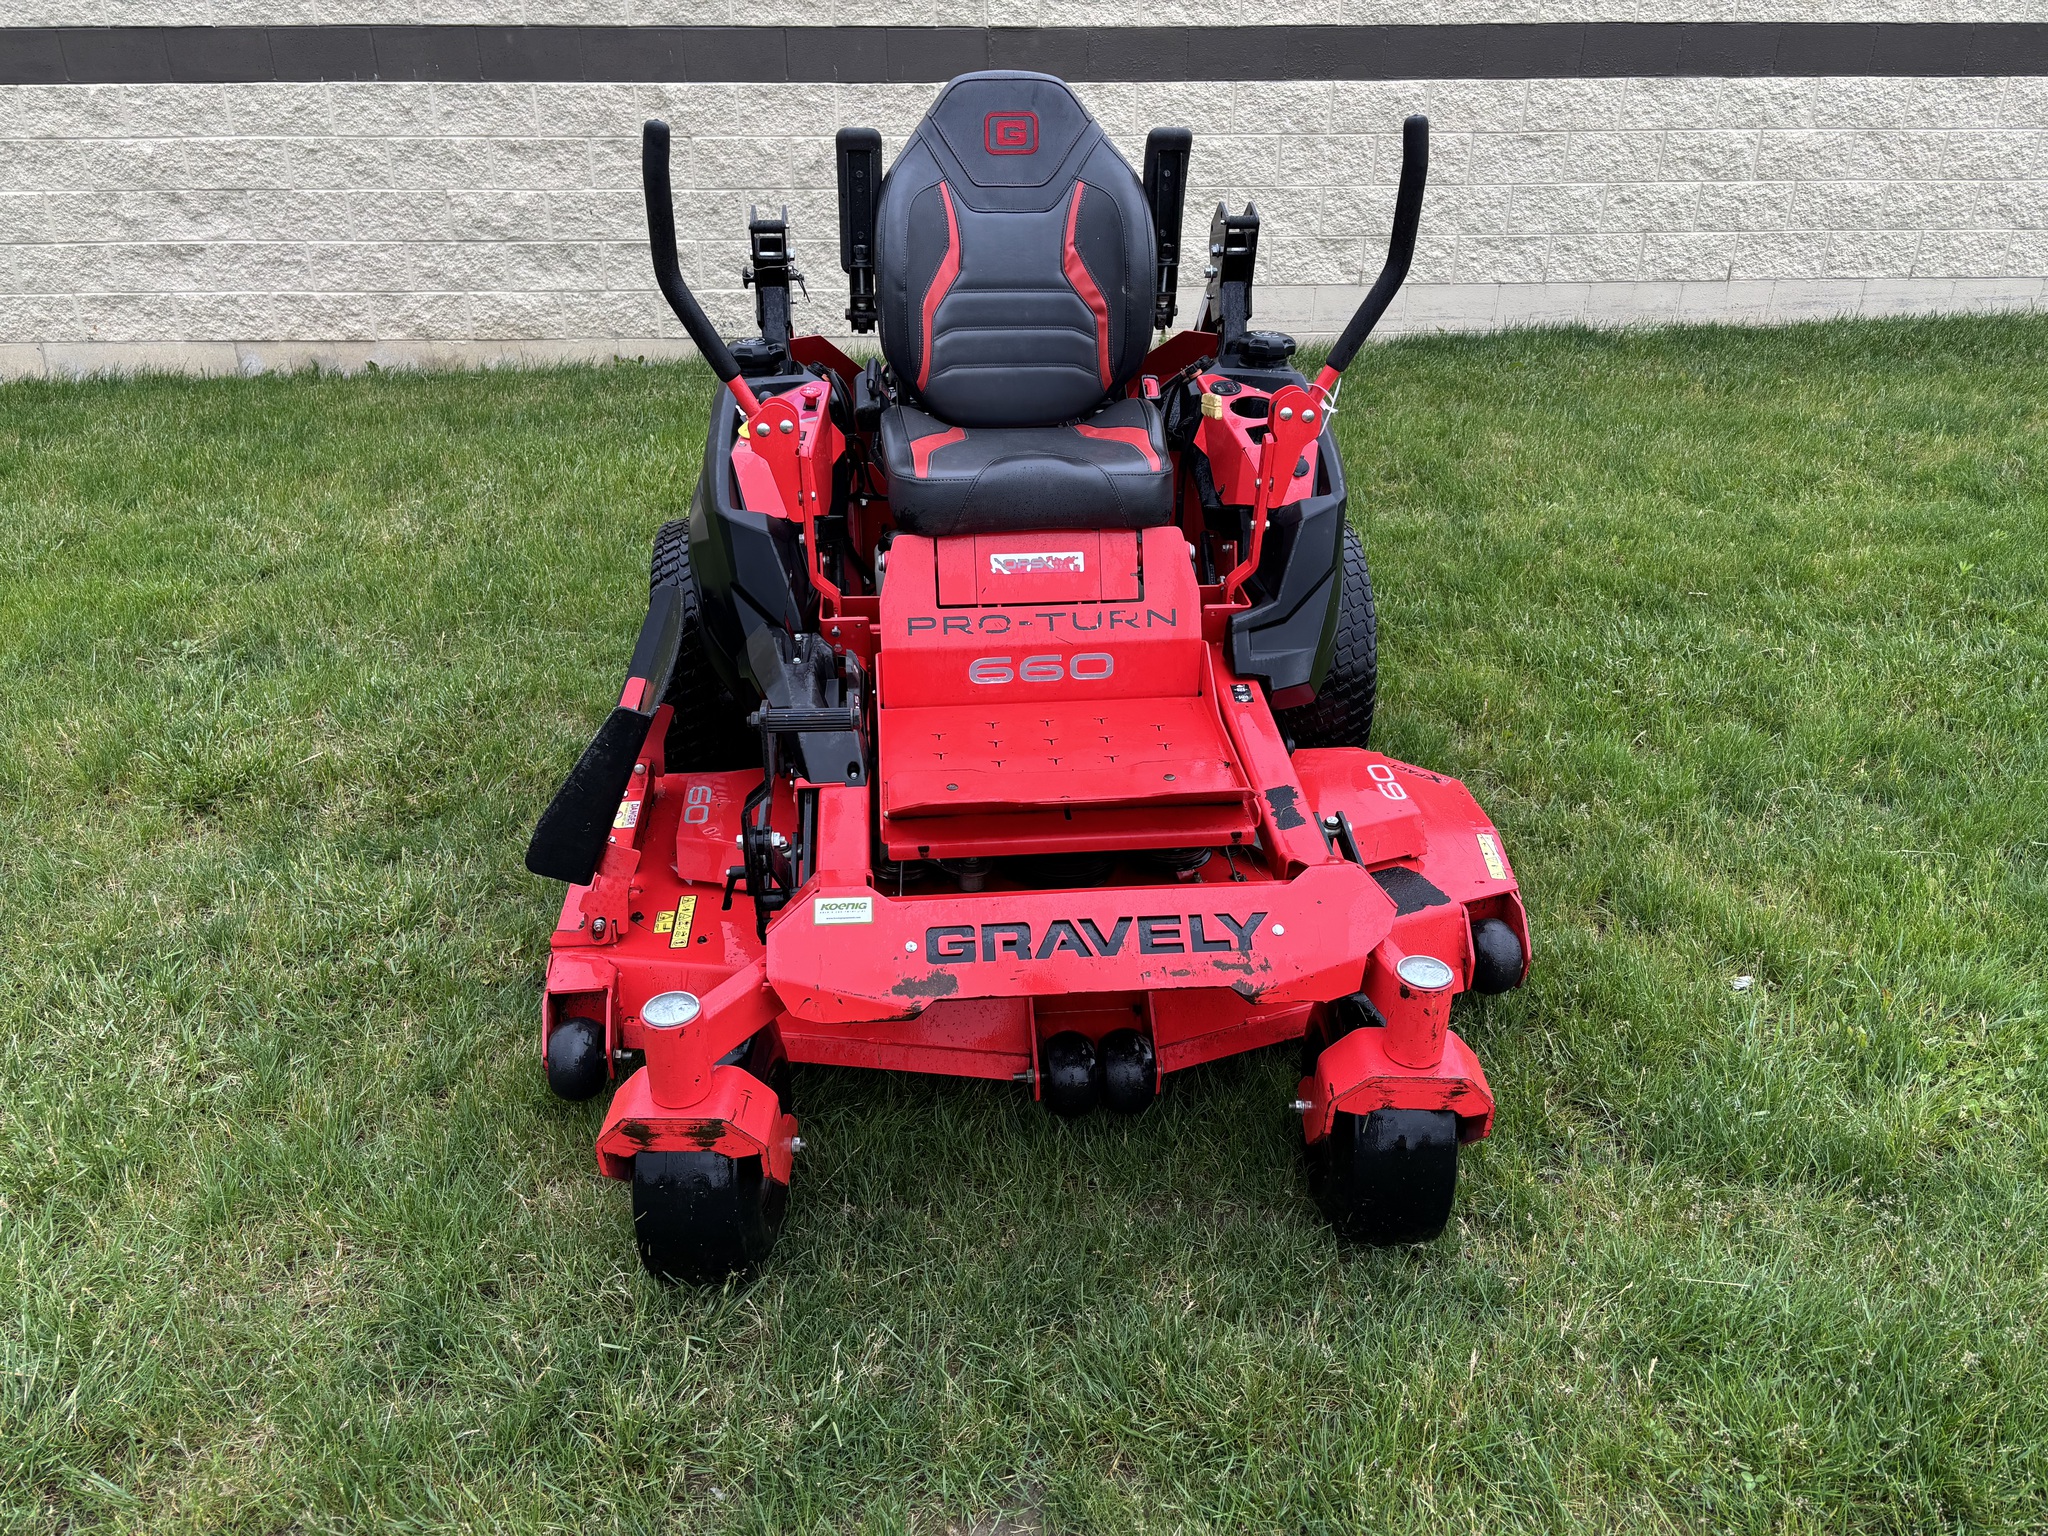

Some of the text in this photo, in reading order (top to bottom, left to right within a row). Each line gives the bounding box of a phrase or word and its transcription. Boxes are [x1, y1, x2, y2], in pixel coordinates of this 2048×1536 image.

[997, 120, 1028, 146] G
[907, 608, 1178, 636] PRO-TURN
[968, 652, 1115, 685] 660
[1366, 764, 1408, 800] 60
[627, 803, 640, 826] DANGER
[683, 785, 712, 824] 60
[925, 911, 1268, 965] GRAVELY
